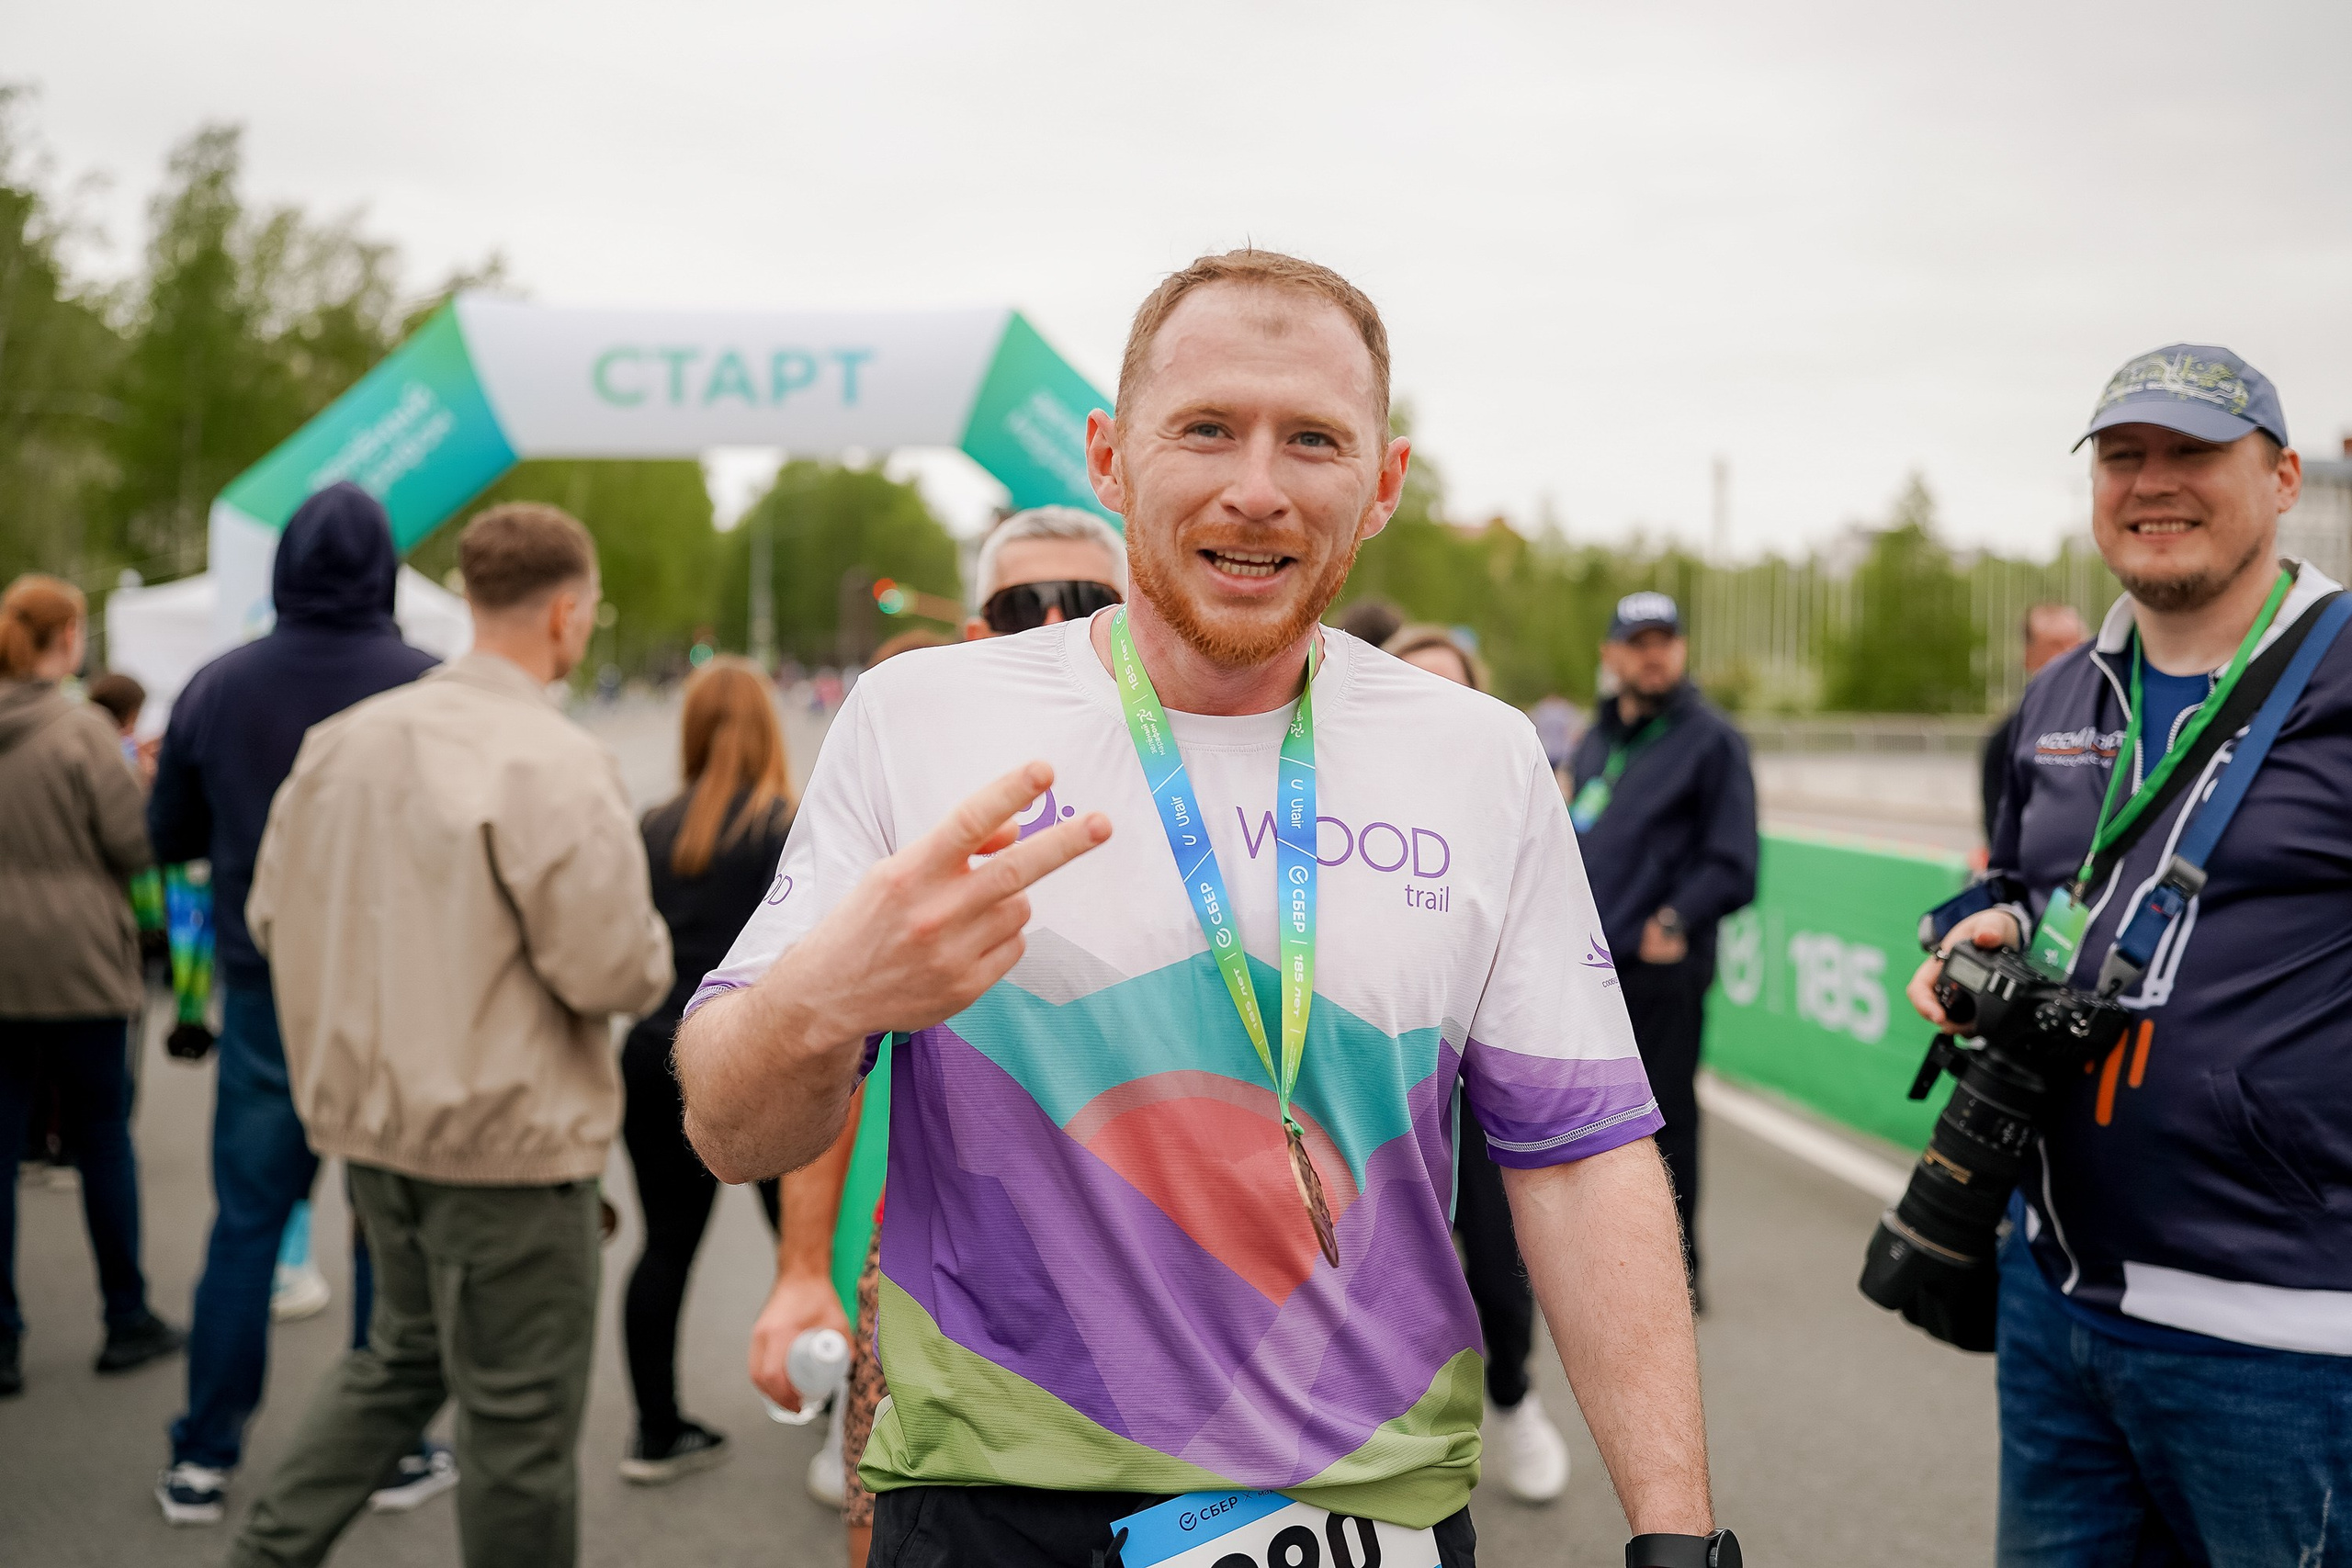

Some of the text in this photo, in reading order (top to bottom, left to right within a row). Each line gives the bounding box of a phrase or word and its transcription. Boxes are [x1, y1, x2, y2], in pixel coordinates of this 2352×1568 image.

[594, 345, 875, 407] СТАРТ
[1125, 664, 1139, 691] 185
[1150, 723, 1166, 756] марафон
[1170, 795, 1191, 827] Utair
[1290, 798, 1304, 829] Utair
[1200, 882, 1223, 925] СБЕР
[1292, 888, 1306, 933] СБЕР
[1404, 884, 1450, 913] trail
[1293, 953, 1304, 1018] 185 лет
[1788, 930, 1889, 1044] 185
[1200, 1495, 1238, 1520] СБЕР
